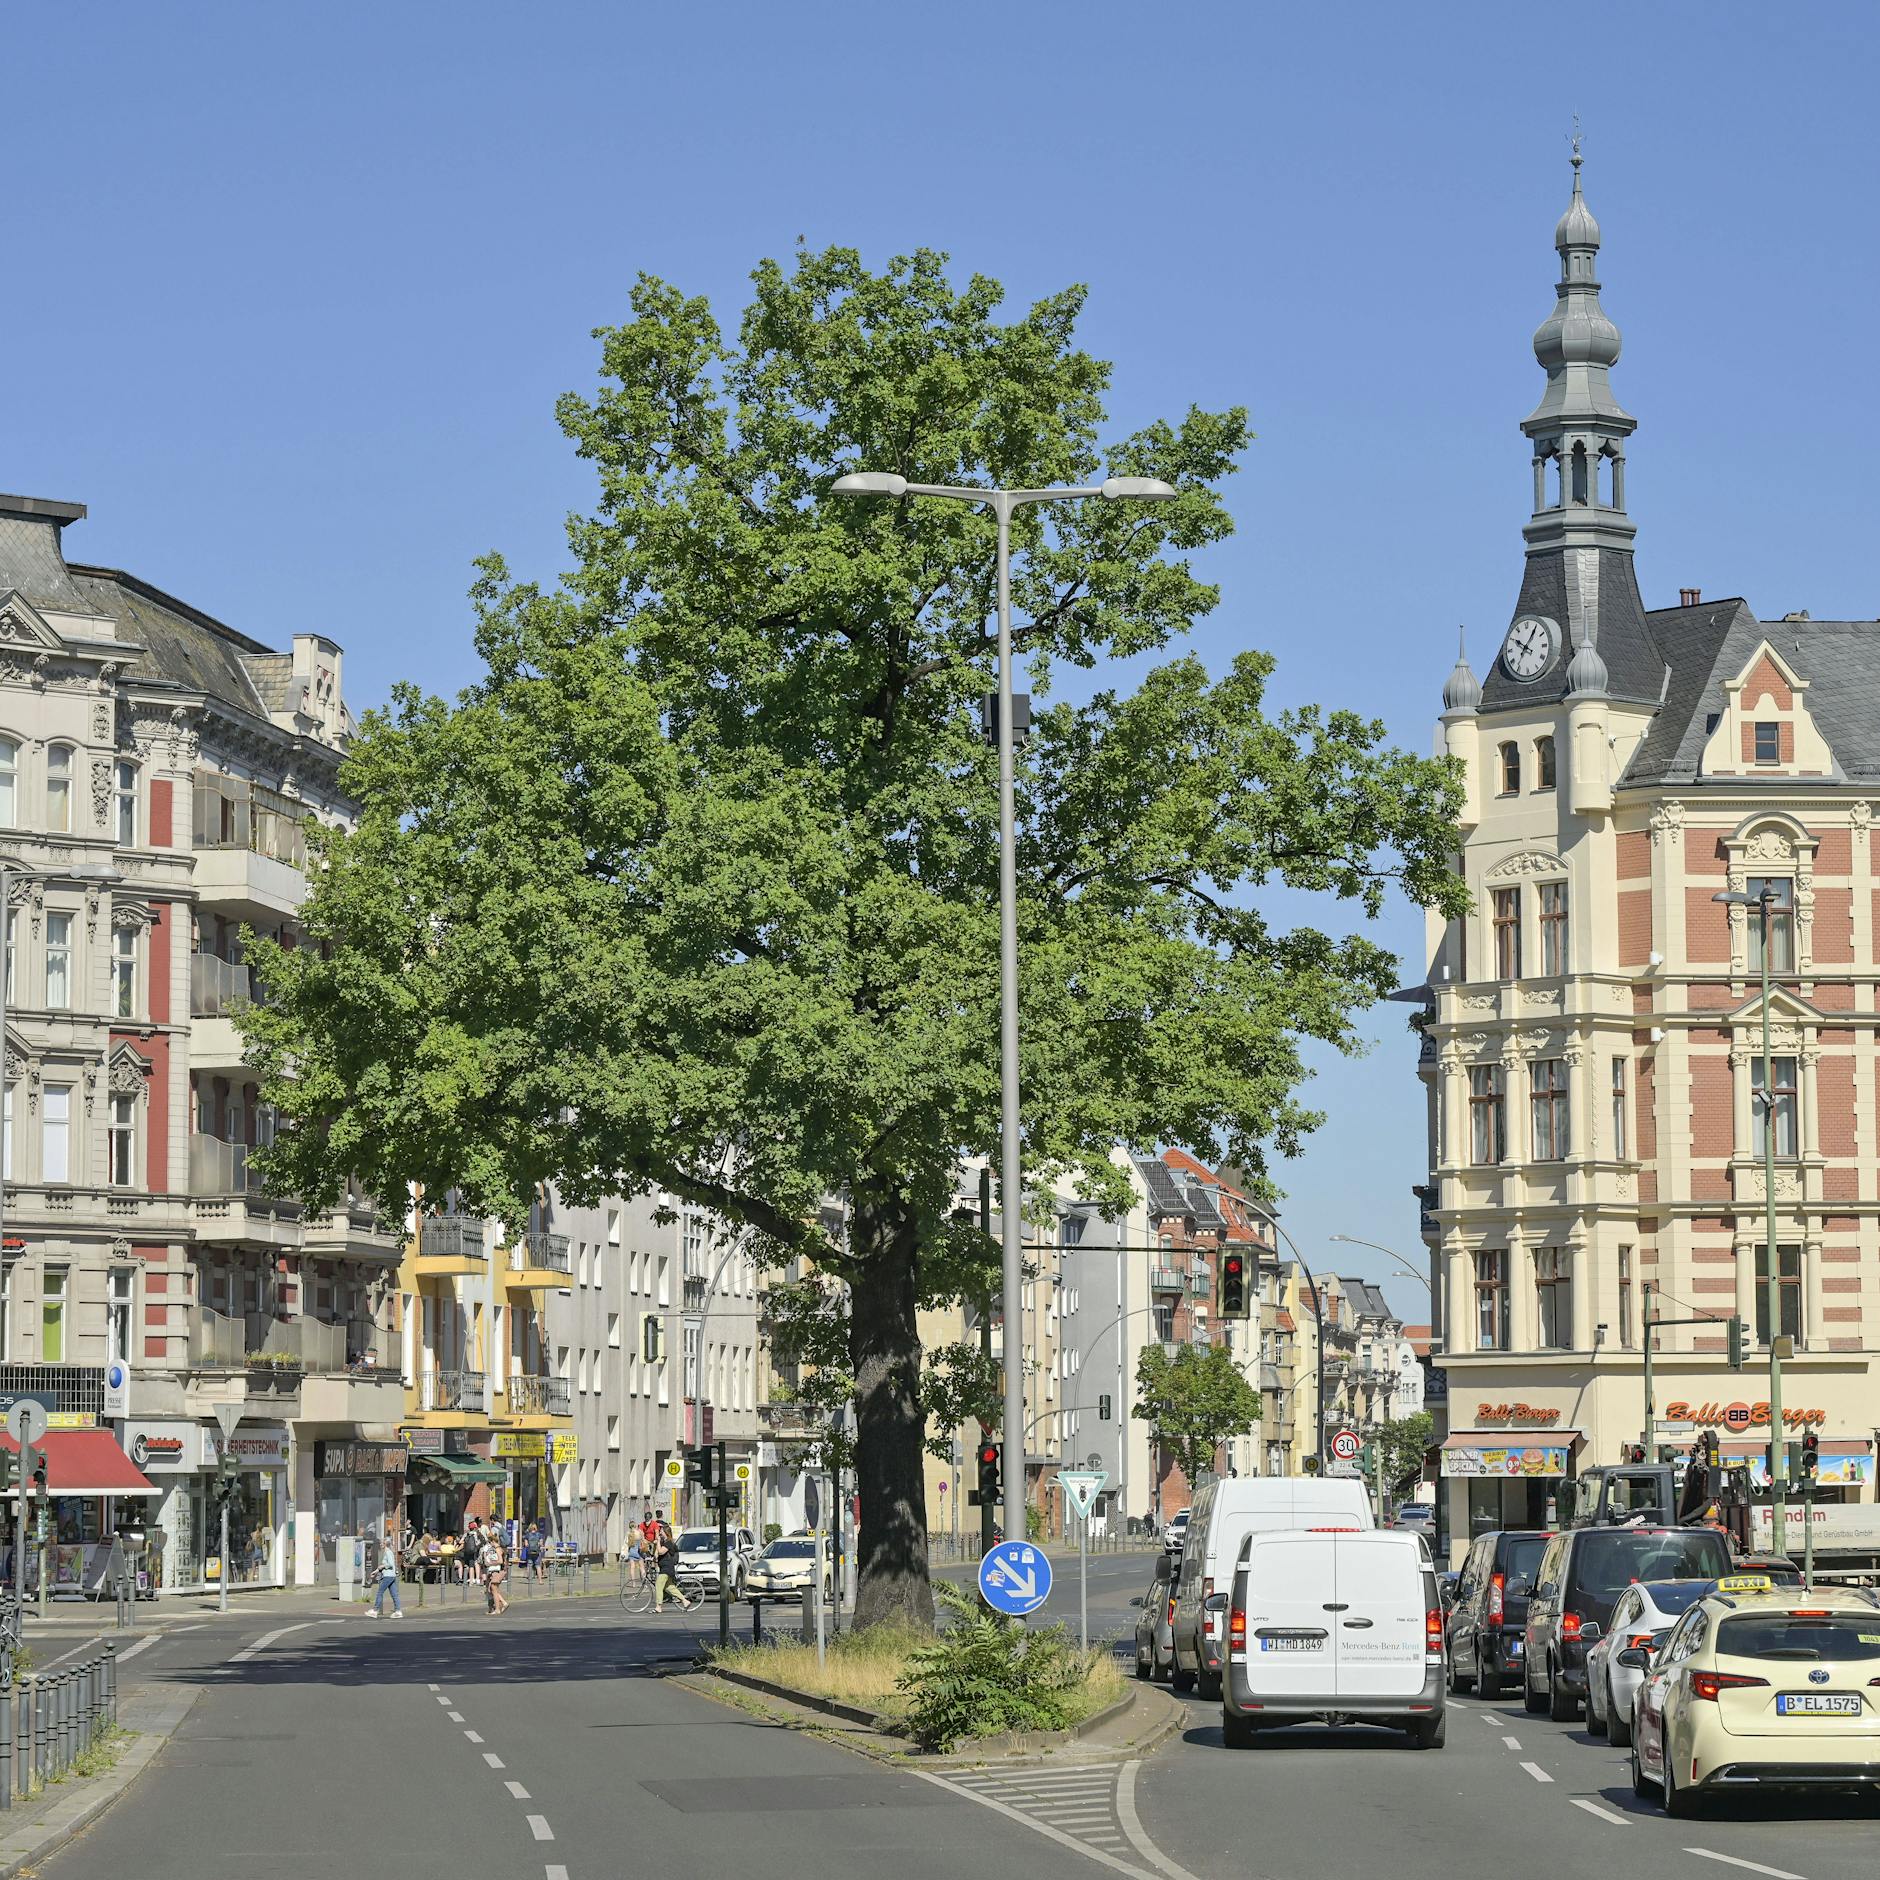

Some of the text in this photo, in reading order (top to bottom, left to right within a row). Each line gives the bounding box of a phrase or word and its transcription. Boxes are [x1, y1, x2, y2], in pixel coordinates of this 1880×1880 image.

[1515, 1403, 1561, 1423] Burger
[1751, 1402, 1826, 1431] Brger
[1338, 1440, 1354, 1451] 30
[1447, 1450, 1479, 1460] SUMMER
[325, 1449, 345, 1473] SUPA
[1448, 1461, 1478, 1472] SPECIAL
[1763, 1509, 1826, 1525] Rndm
[1855, 1529, 1873, 1537] GmbH
[1729, 1577, 1762, 1588] TAXI
[1268, 1639, 1323, 1649] WI MD 1849
[1342, 1642, 1401, 1651] Mercedes-Benz
[1787, 1697, 1859, 1711] B EL 1575
